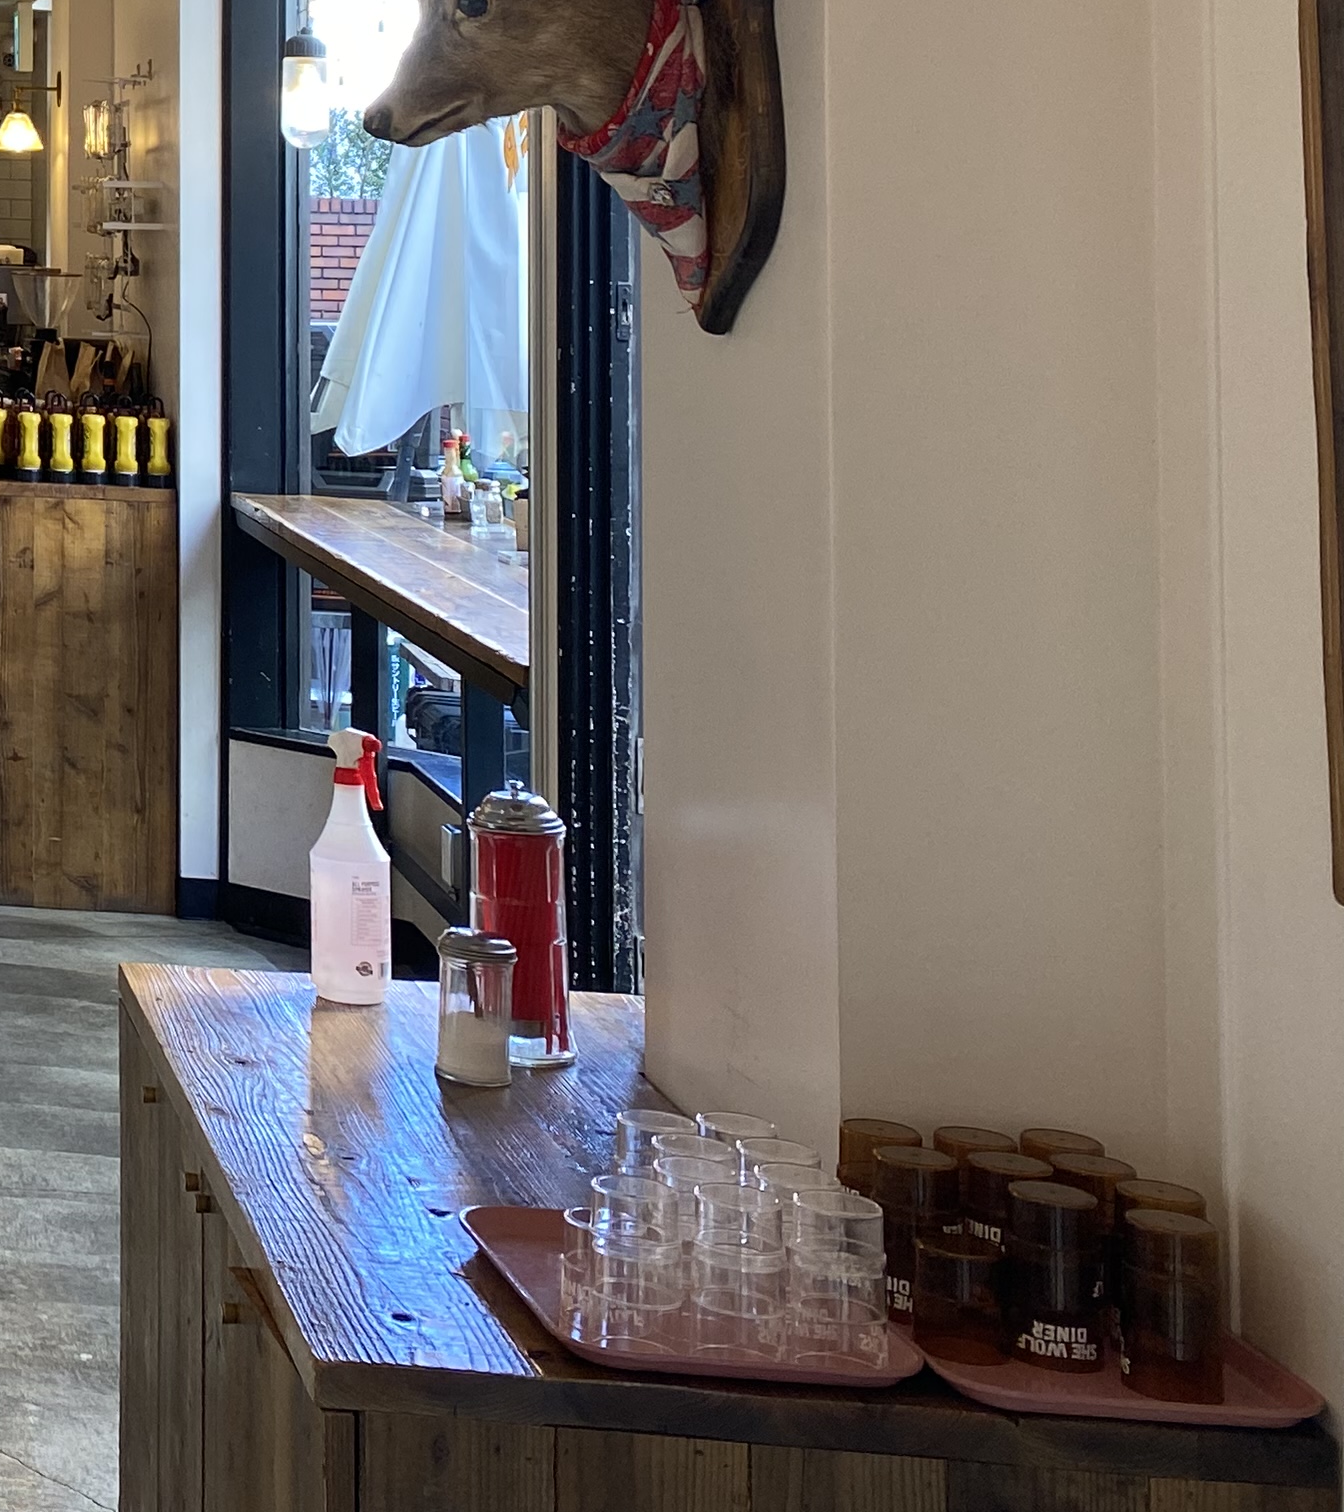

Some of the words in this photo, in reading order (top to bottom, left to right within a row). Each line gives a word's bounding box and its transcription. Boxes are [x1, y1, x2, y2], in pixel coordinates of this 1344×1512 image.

[1033, 1319, 1087, 1343] DINER
[1016, 1333, 1069, 1359] WOLF
[1071, 1342, 1097, 1360] SHE
